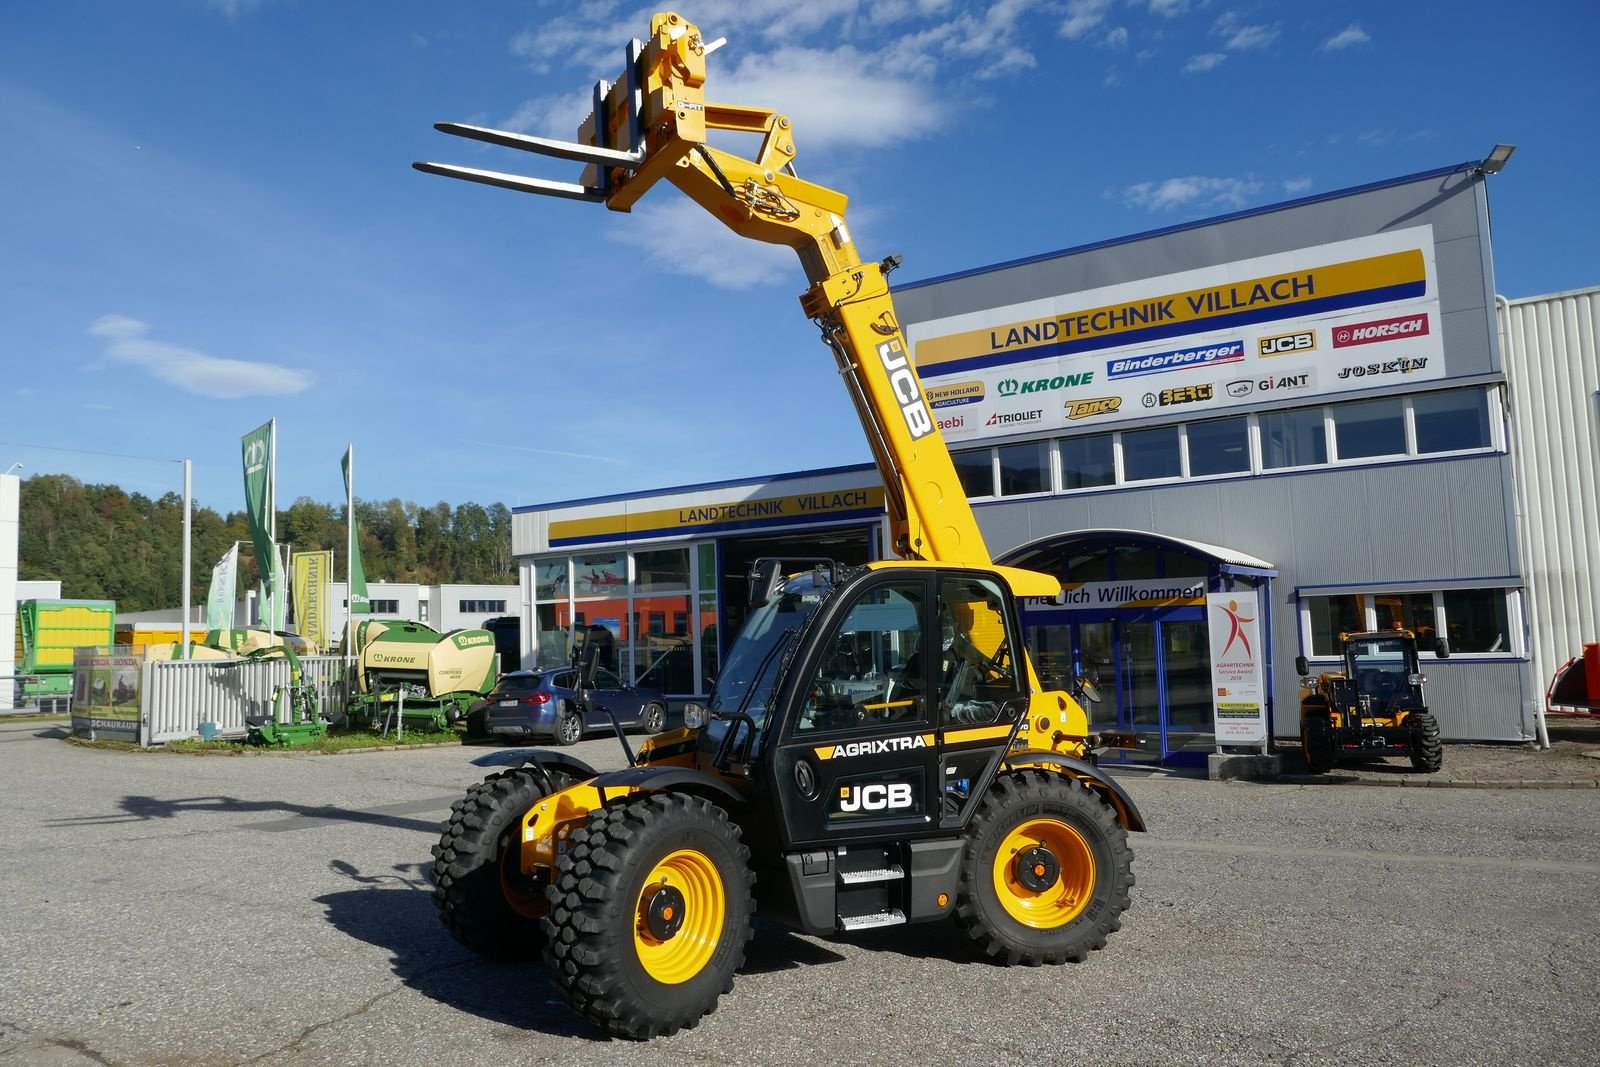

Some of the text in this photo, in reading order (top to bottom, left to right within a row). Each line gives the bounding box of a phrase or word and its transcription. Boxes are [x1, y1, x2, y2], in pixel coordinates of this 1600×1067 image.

[991, 274, 1315, 350] LANDTECHNIK VILLACH
[1352, 319, 1423, 341] HORSCH
[1262, 333, 1313, 354] JCB
[1111, 343, 1240, 374] Binderberger
[1338, 357, 1428, 378] JOSKIN
[879, 343, 932, 438] JCB
[934, 386, 980, 399] NEW HOLLAND
[1020, 371, 1095, 394] KRONE
[934, 398, 969, 408] AGRICULTURE
[1064, 396, 1122, 420] Tanco
[997, 409, 1043, 424] TRIOLIET
[679, 491, 867, 524] LANDTECHNIK VILLACH
[1097, 584, 1205, 602] Willkommen
[467, 635, 490, 645] KRONE
[113, 658, 138, 667] HONDA
[832, 735, 926, 759] AGRIXTRA
[840, 783, 912, 812] JCB
